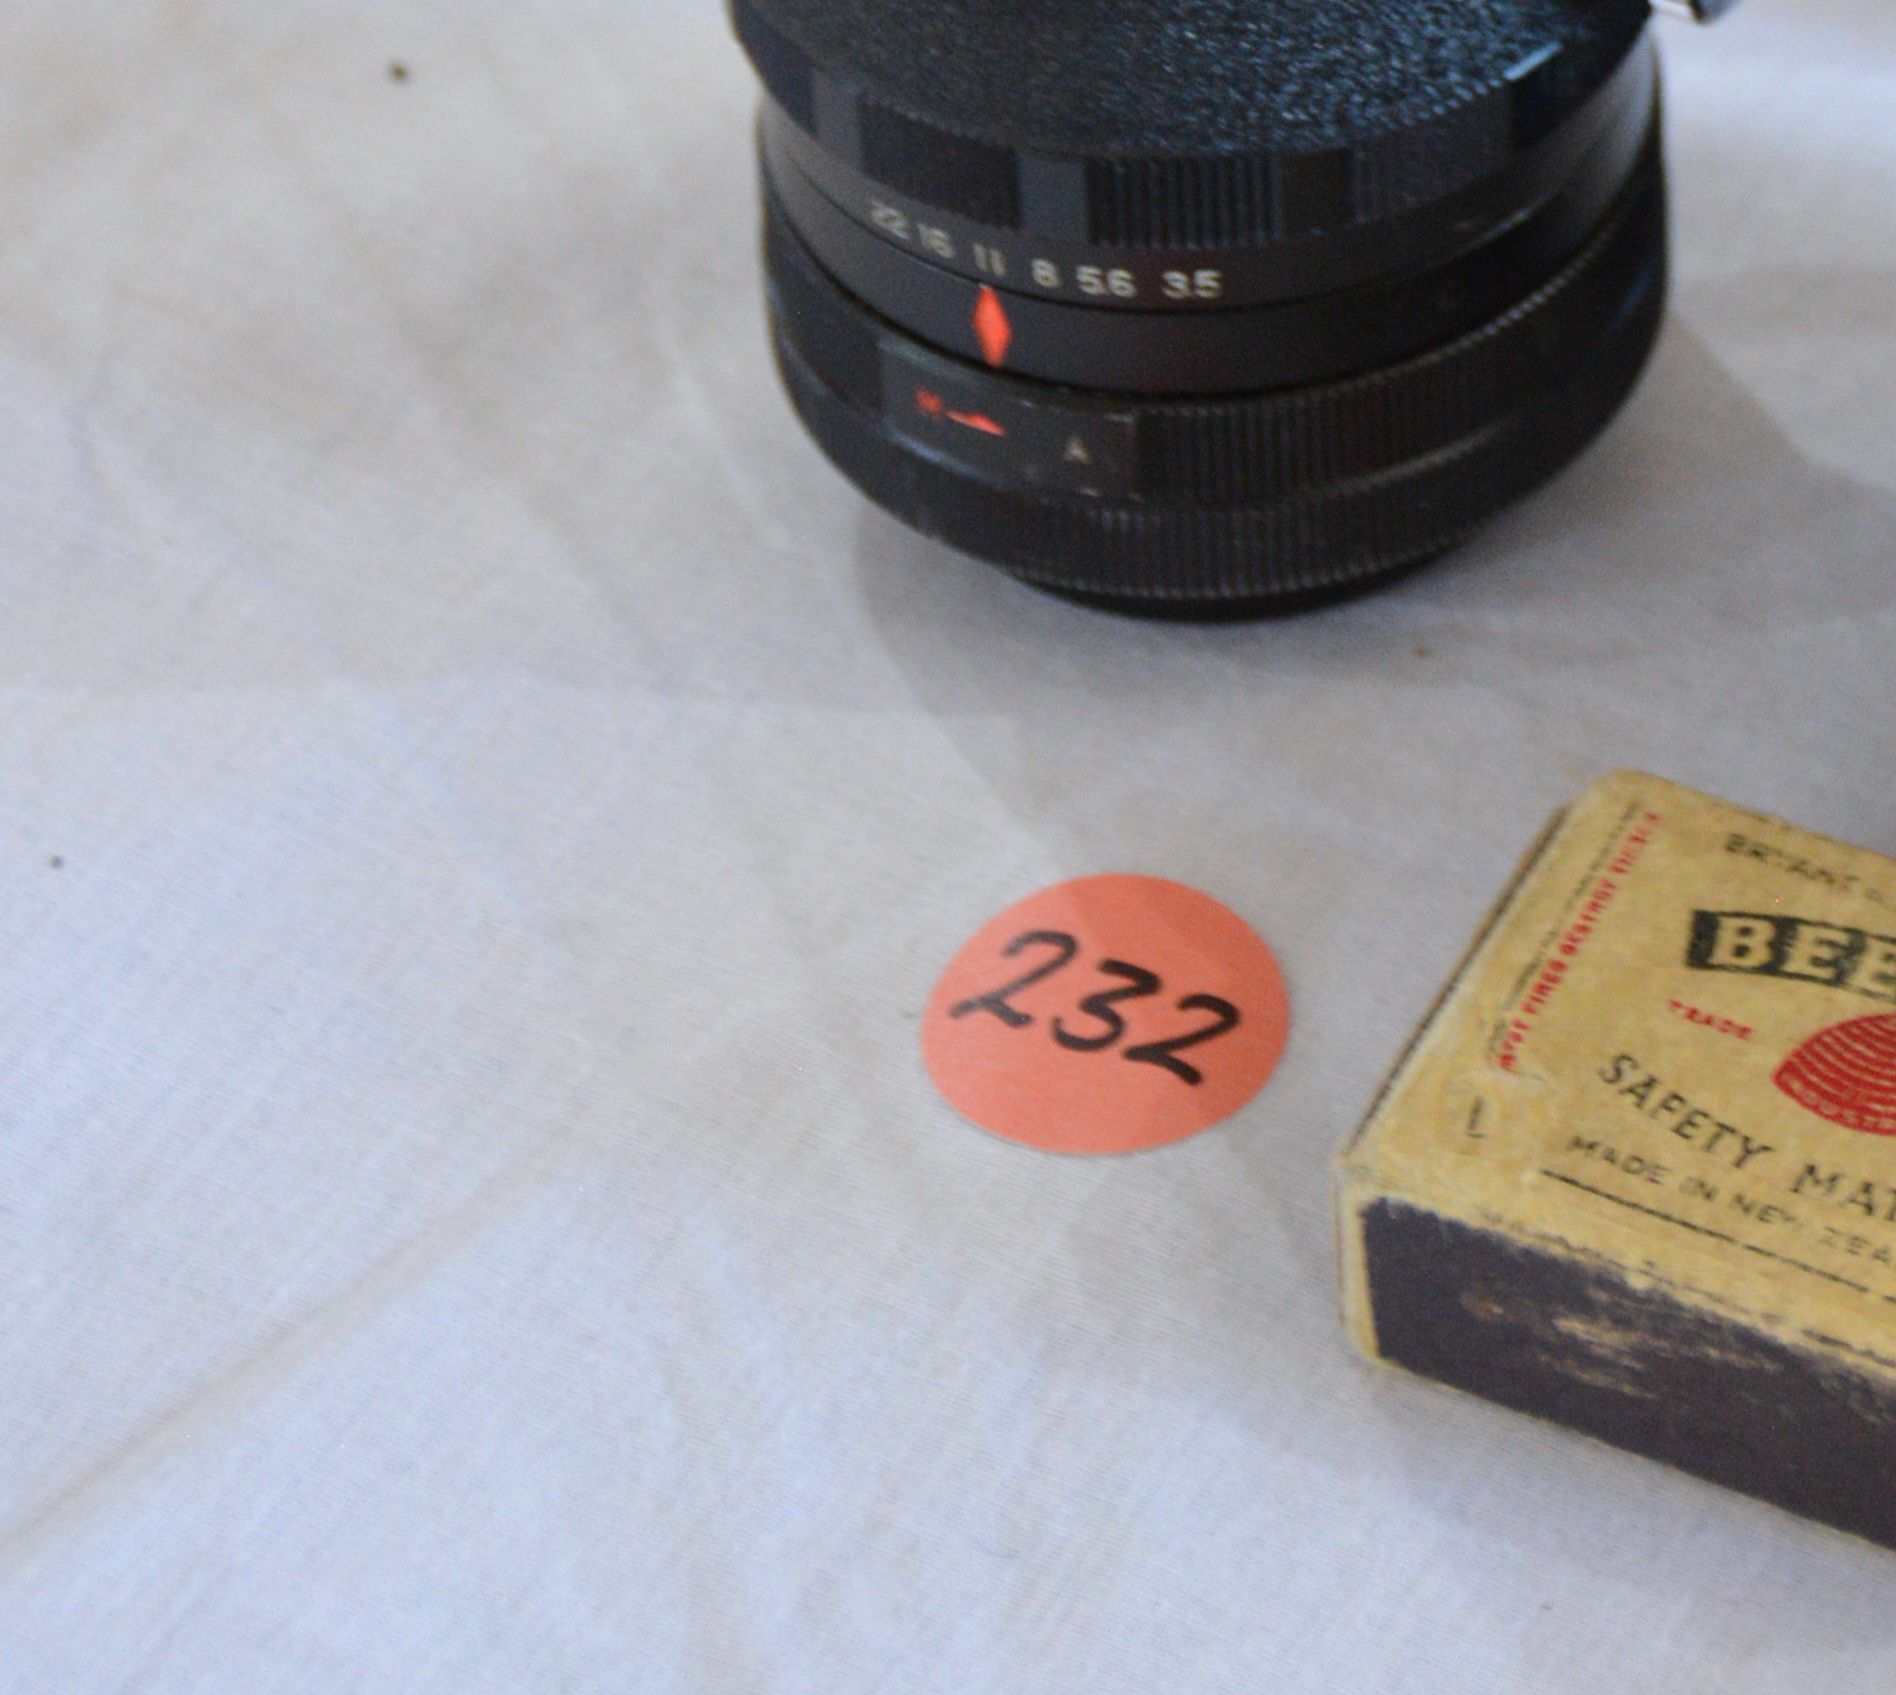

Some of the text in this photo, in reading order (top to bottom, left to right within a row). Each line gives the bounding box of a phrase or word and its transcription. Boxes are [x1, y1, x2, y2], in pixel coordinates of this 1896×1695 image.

[973, 242, 1007, 279] 11
[1031, 257, 1063, 289] 8
[949, 929, 1243, 1087] 232
[1598, 1053, 1776, 1170] SAFETY
[1566, 1134, 1673, 1186] MADE
